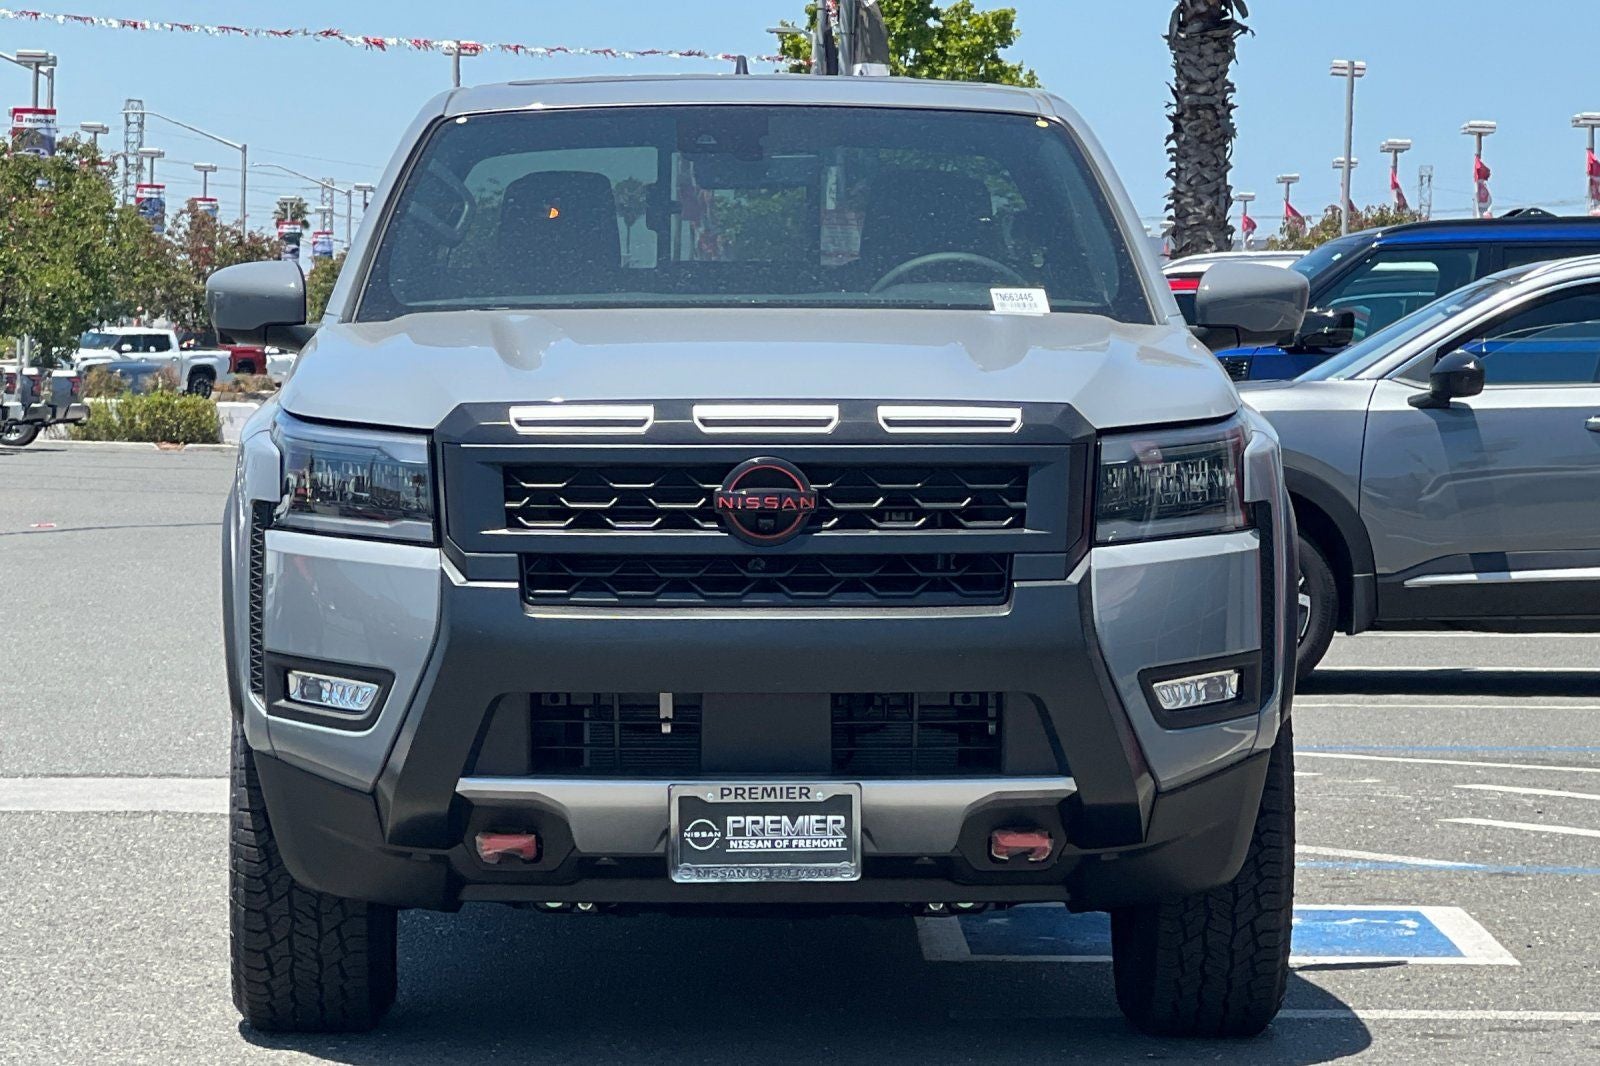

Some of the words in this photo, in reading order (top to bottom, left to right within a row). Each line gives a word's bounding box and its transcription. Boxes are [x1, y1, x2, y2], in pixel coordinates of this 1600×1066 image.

[718, 497, 815, 510] NISSAN
[720, 786, 811, 800] PREMIER
[726, 815, 846, 837] PREMIER
[729, 840, 771, 849] NISSAN
[774, 839, 790, 848] OF
[792, 838, 844, 848] FREMONT
[696, 867, 747, 879] NISSAN
